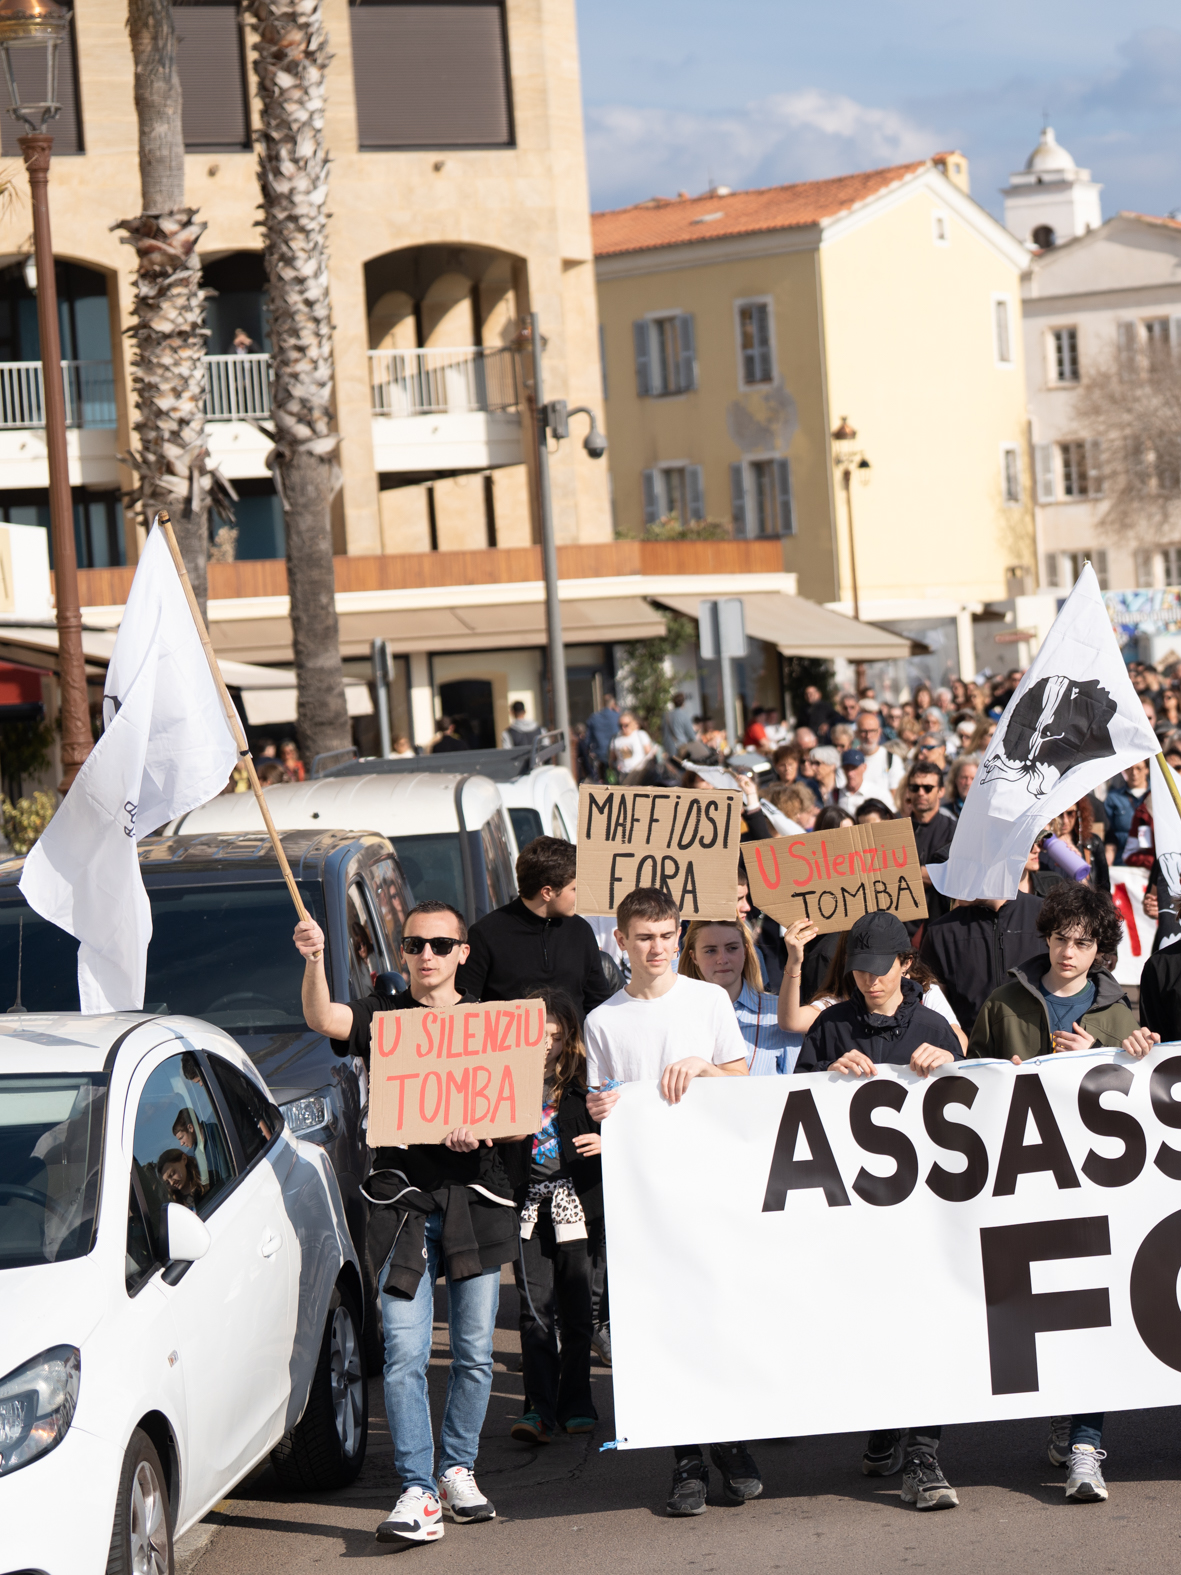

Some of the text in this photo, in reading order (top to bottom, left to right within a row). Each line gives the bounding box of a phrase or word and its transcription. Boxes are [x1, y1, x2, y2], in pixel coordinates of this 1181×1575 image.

[609, 852, 699, 914] FORA
[754, 840, 908, 890] U Silenziu
[790, 875, 919, 921] TOMBA
[377, 1015, 402, 1058] U
[386, 1065, 516, 1131] TOMBA
